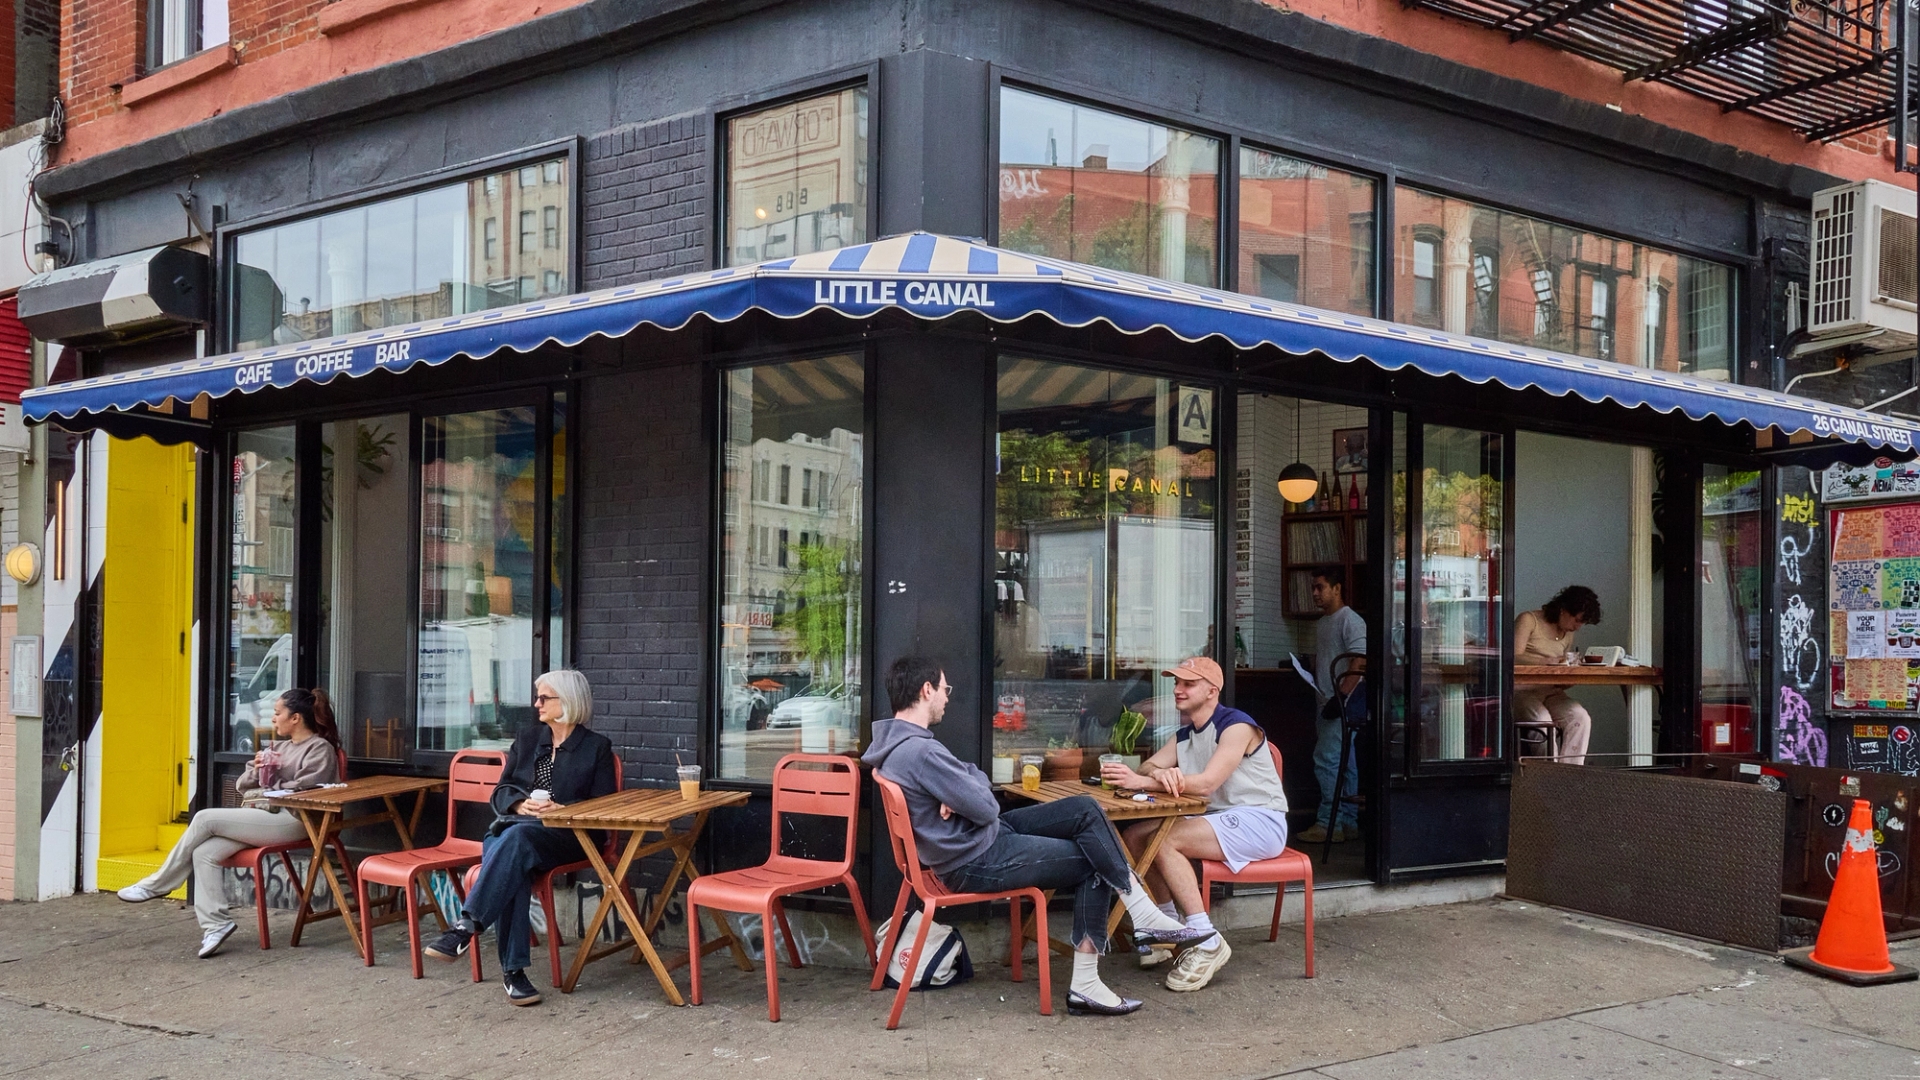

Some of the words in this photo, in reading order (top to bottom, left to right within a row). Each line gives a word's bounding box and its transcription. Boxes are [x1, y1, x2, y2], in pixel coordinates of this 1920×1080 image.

[815, 280, 897, 304] LITTLE
[904, 281, 995, 307] CANAL
[235, 363, 273, 386] CAFE
[295, 349, 354, 376] COFFEE
[375, 340, 411, 364] BAR
[1183, 394, 1208, 430] A
[1813, 414, 1830, 431] 26
[1830, 417, 1872, 438] CANAL
[1871, 425, 1912, 445] STREET
[1021, 465, 1100, 488] LITTLE
[1115, 476, 1192, 497] CANAL
